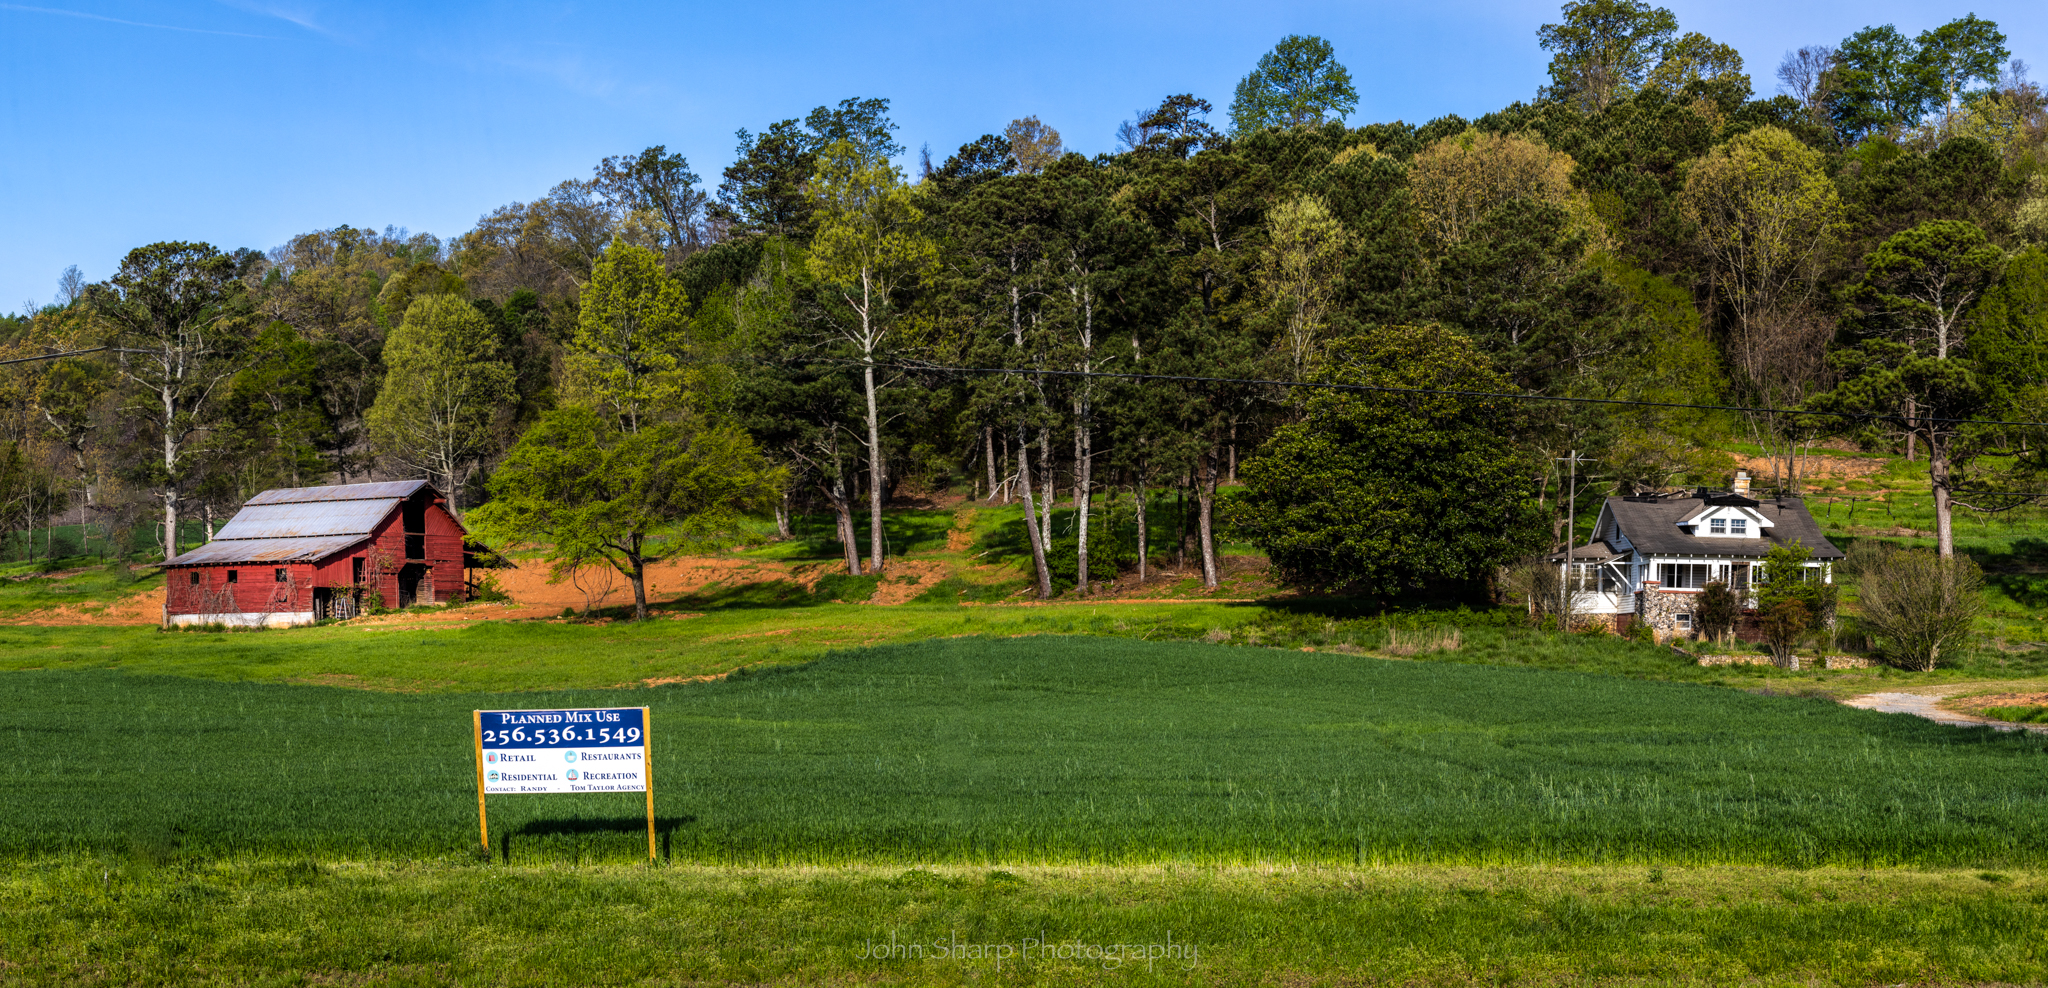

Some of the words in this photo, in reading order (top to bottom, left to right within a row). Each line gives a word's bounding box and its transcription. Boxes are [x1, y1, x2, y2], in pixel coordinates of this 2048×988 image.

[502, 712, 562, 724] PLANNED
[565, 712, 592, 723] MIX
[595, 711, 620, 722] USE
[483, 725, 641, 745] 256.536.1549
[500, 754, 536, 762] RETAIL
[581, 752, 642, 761] RESTAURANTS
[501, 773, 558, 781] RESIDENTIAL
[583, 772, 638, 780] RECREATION
